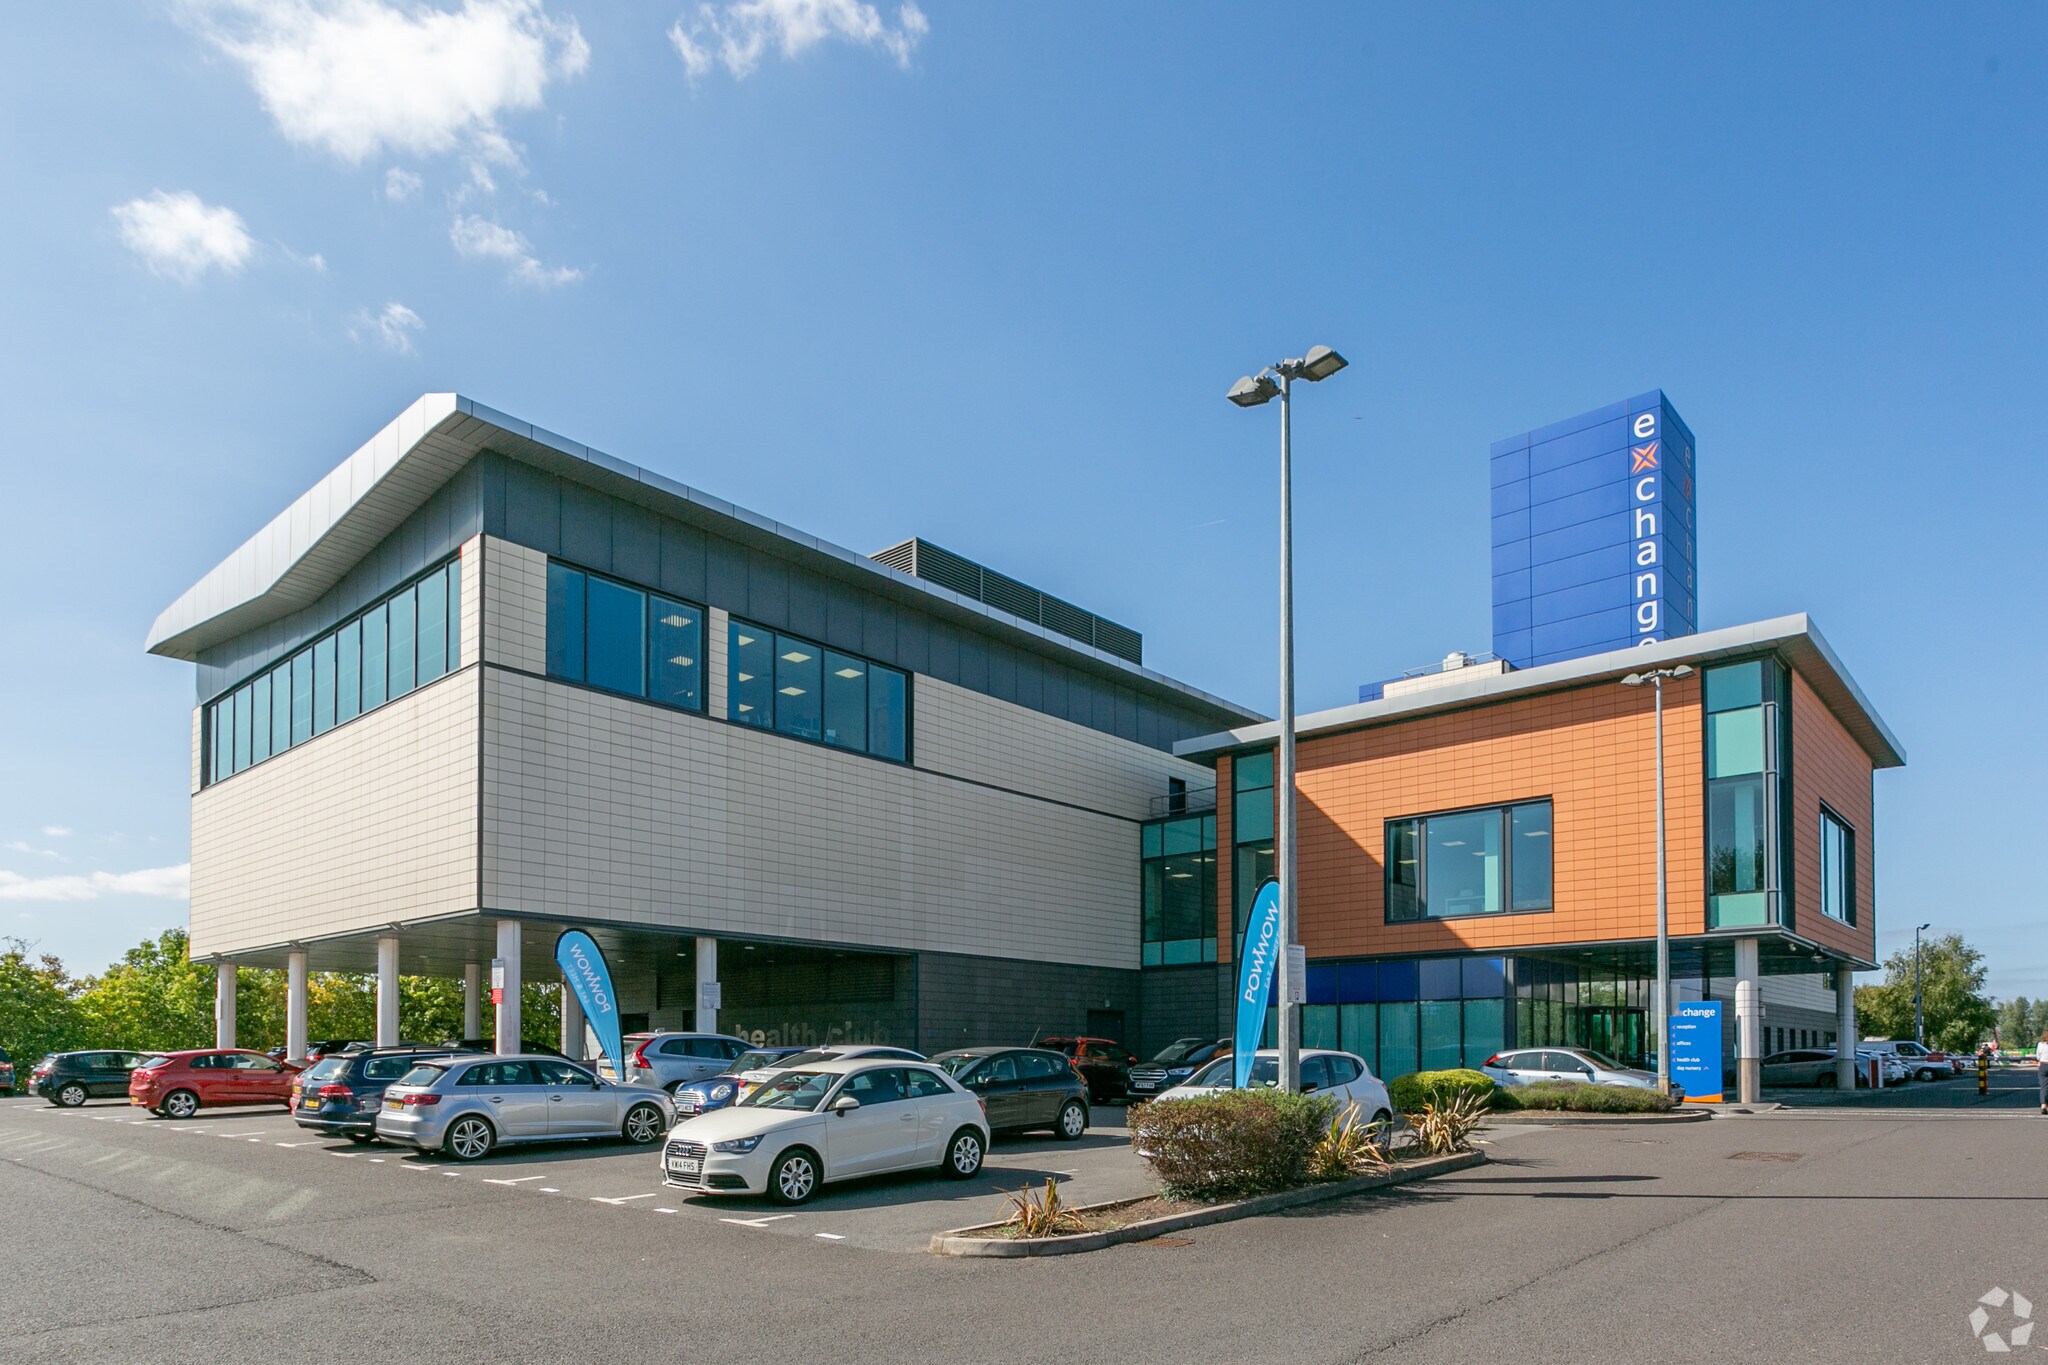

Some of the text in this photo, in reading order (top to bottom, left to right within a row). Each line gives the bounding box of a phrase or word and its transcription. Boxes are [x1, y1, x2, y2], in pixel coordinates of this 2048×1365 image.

[1244, 900, 1280, 1003] POWWOW
[735, 1022, 817, 1048] health
[683, 1161, 695, 1171] FHS
